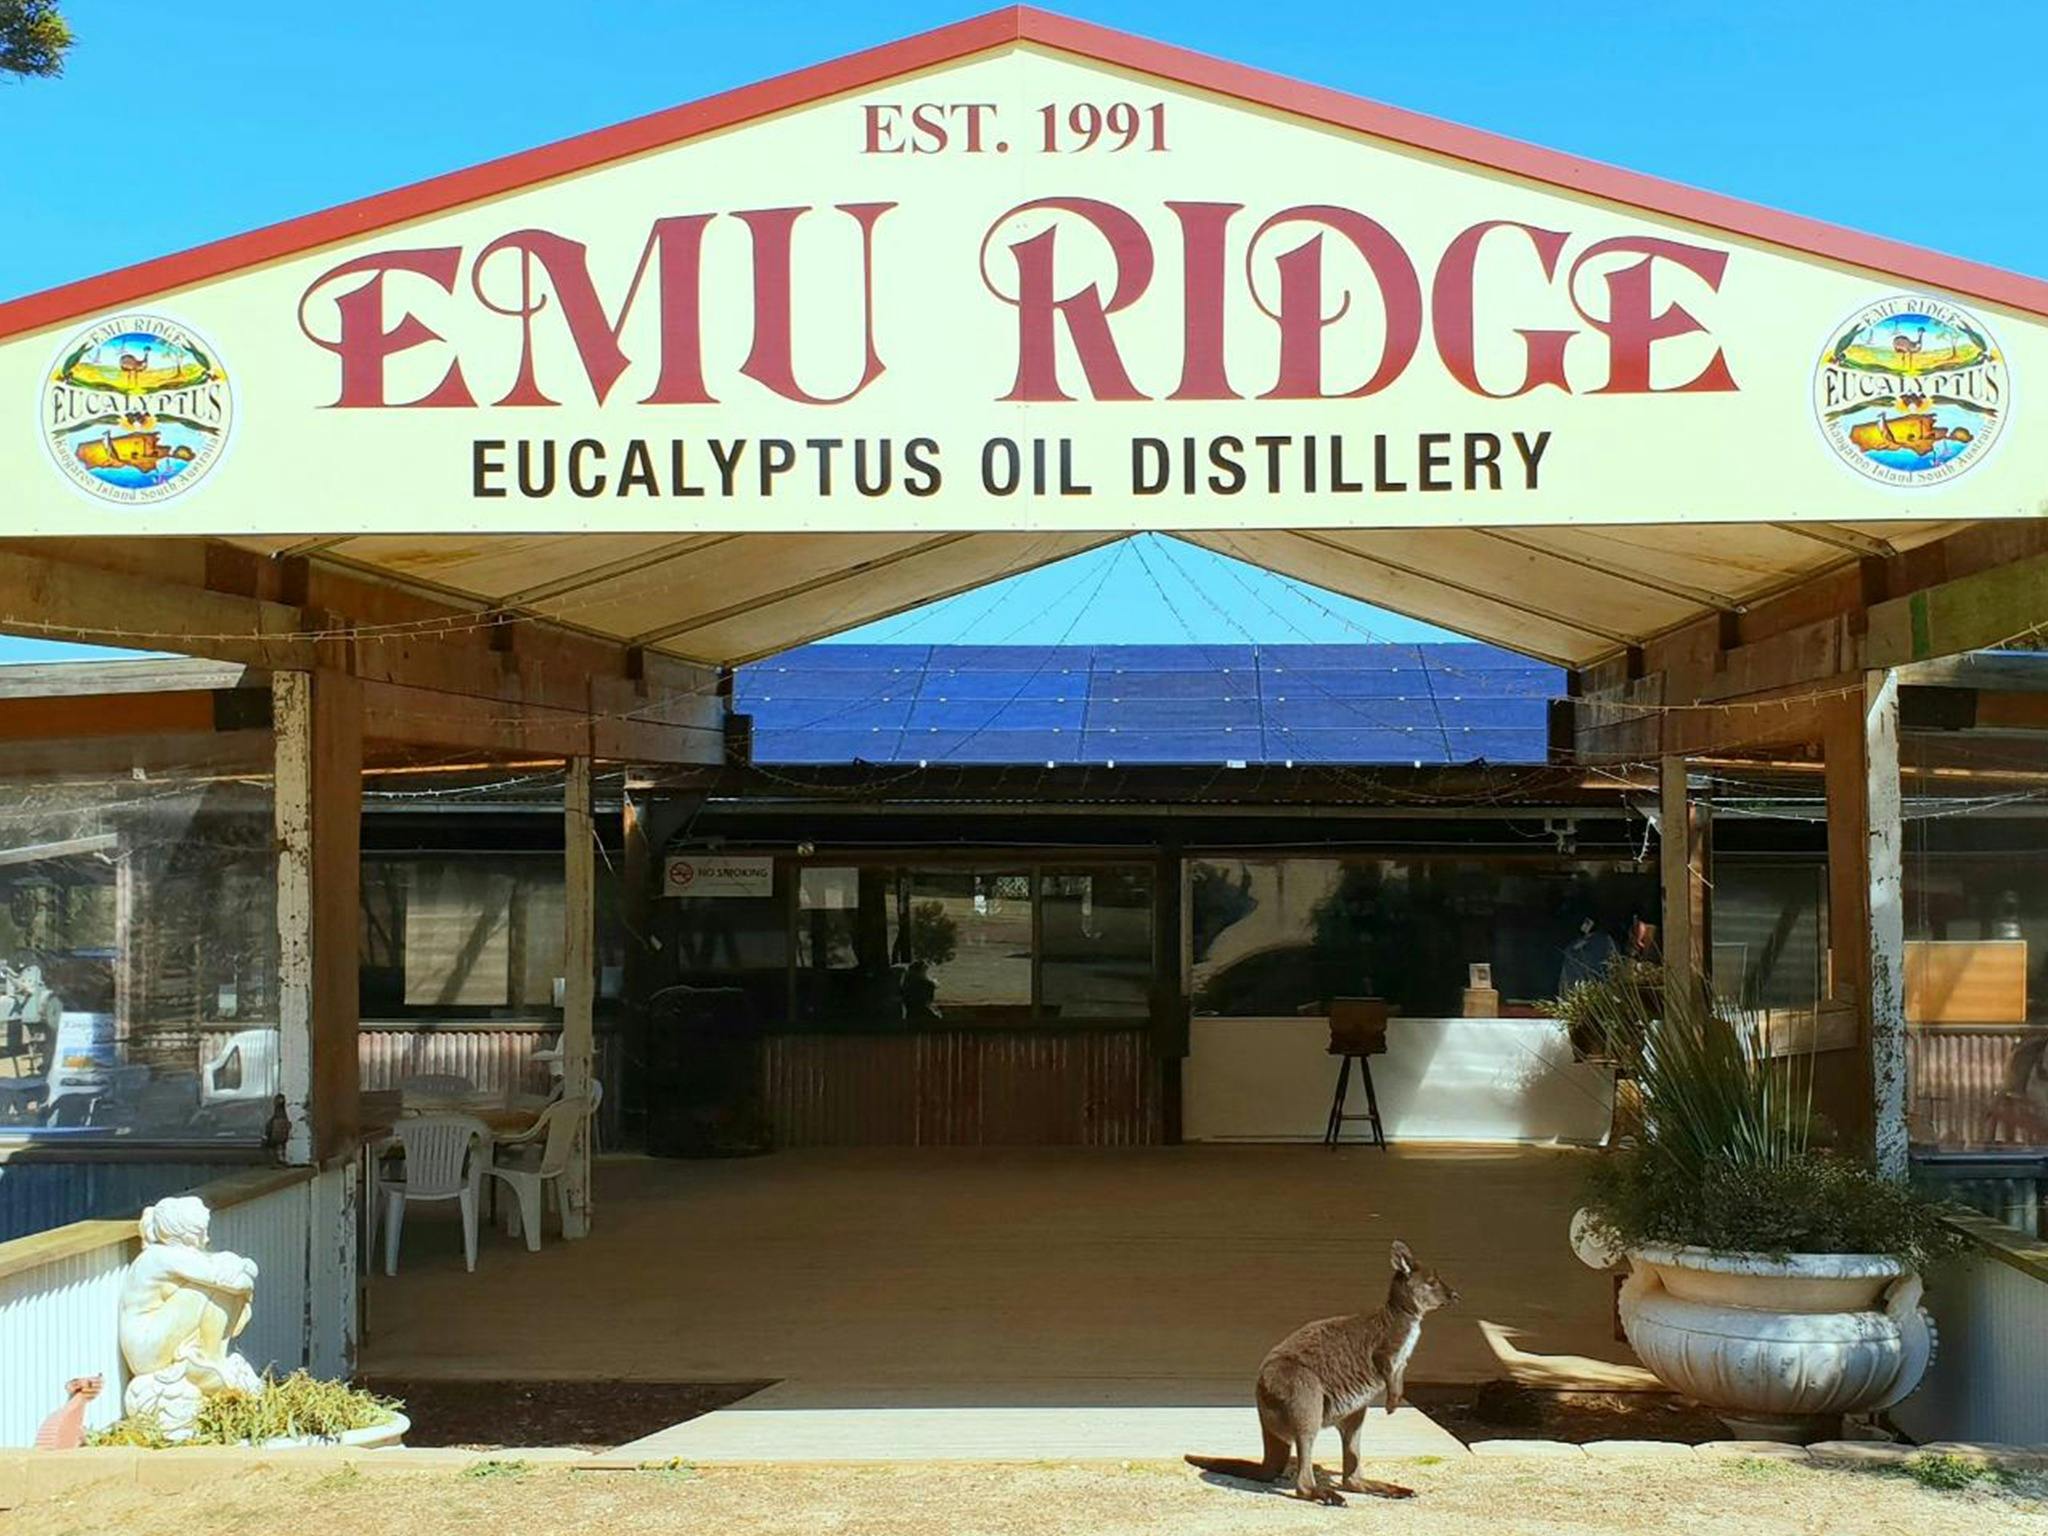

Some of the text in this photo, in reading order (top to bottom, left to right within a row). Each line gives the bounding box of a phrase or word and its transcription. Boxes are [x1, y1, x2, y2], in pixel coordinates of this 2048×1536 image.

[860, 102, 1171, 153] EST. 1991
[297, 196, 1741, 409] EMU RIDGE
[1862, 299, 1960, 327] EMU RIDGE
[90, 318, 188, 347] EMU RIDGE
[52, 384, 222, 426] EUCALYPTUS
[1824, 364, 2000, 408] EUCALYPTUS
[55, 437, 220, 501] Kangaroo Island South Australia
[474, 432, 1552, 499] EUCALYPTUS OIL DISTILLERY
[1827, 418, 1997, 484] Kangaroo Island South Australia
[698, 868, 768, 878] NO SMOKING
